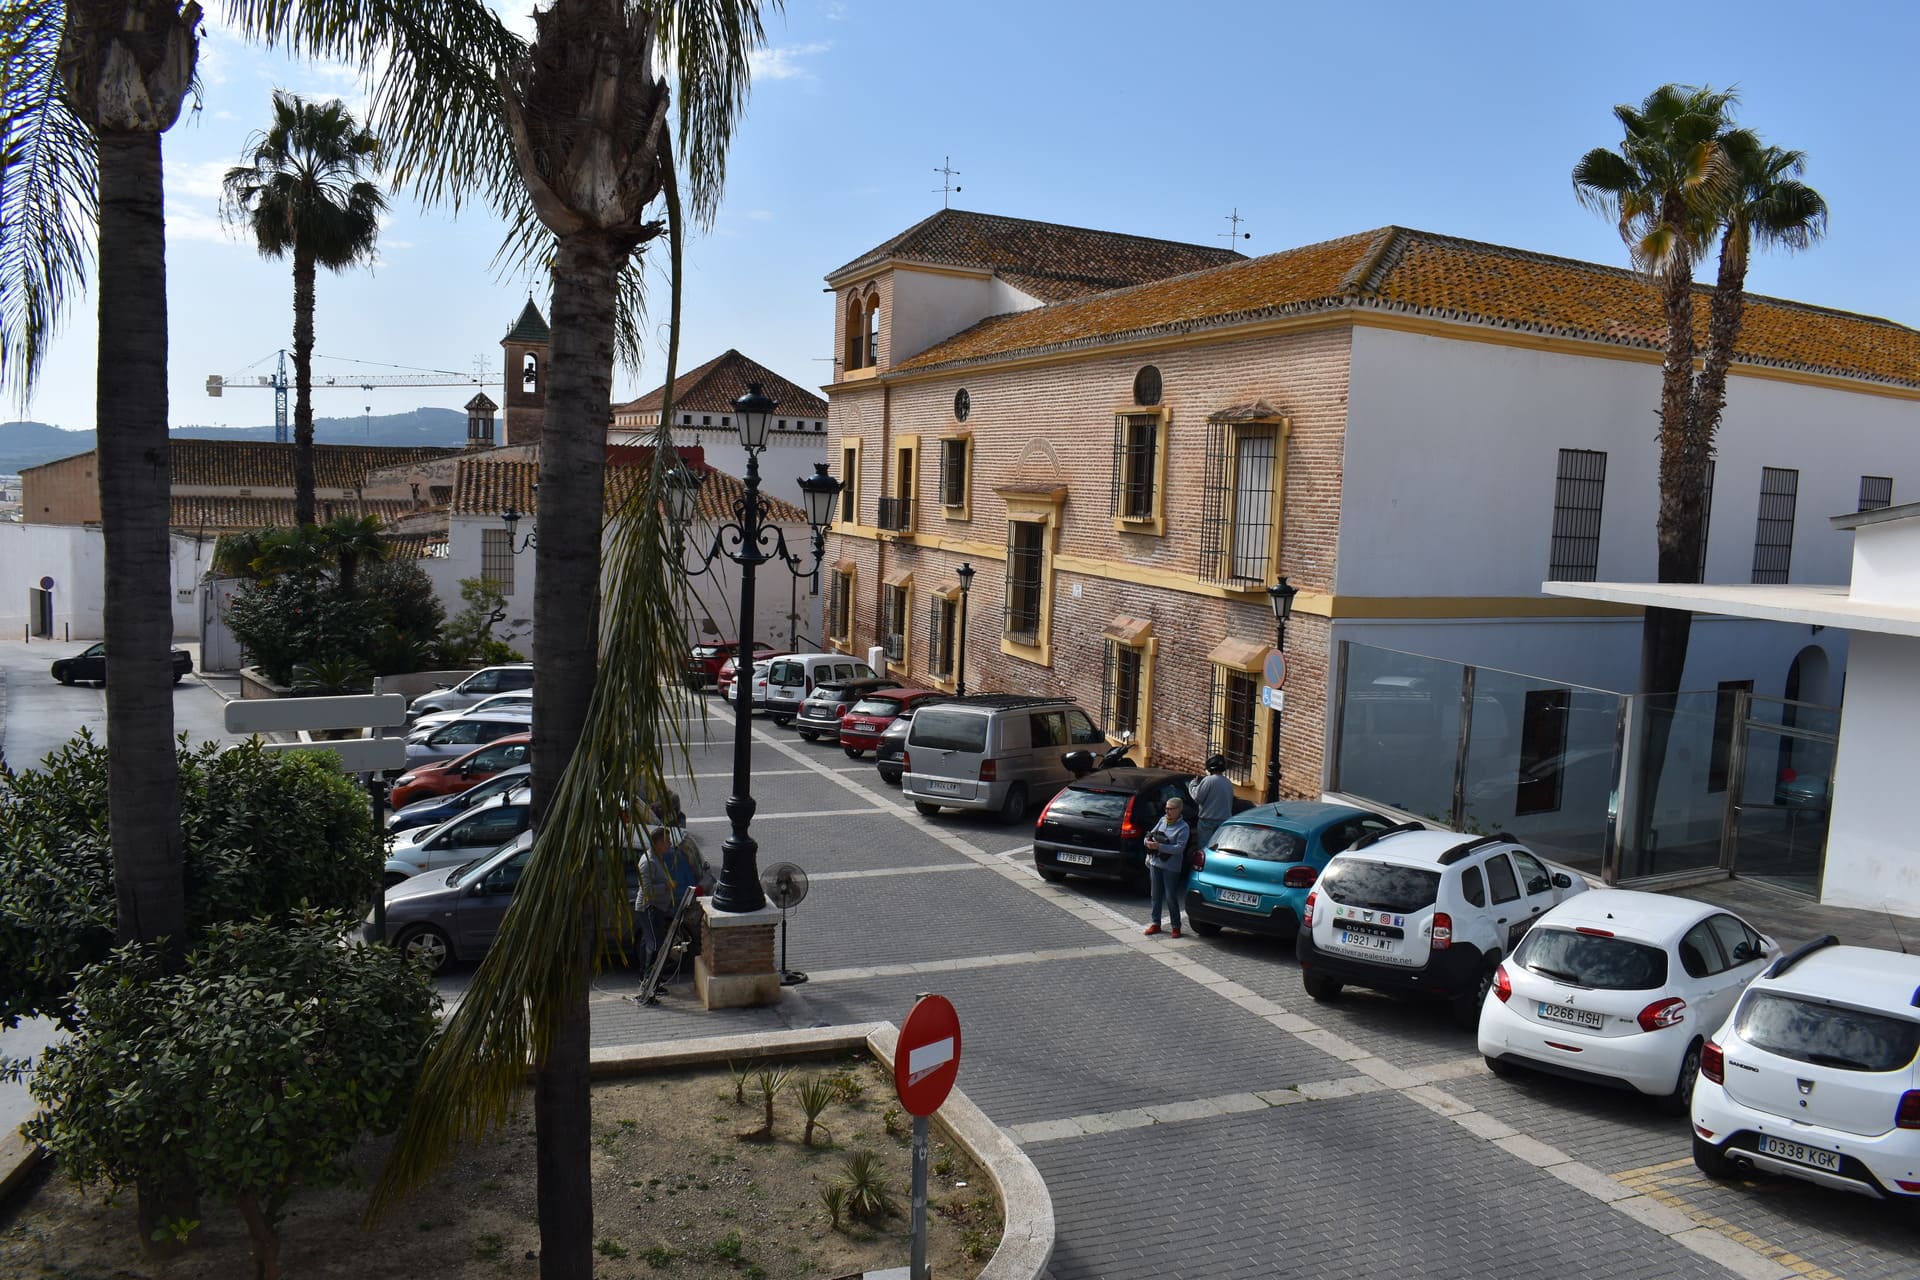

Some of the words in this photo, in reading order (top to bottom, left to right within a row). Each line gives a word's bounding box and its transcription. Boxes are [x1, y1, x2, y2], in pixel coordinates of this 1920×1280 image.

[1346, 924, 1387, 936] DUSTER
[1347, 933, 1370, 946] 0921
[1373, 938, 1393, 951] JWT
[1546, 1005, 1574, 1020] 0266
[1577, 1011, 1600, 1025] HSH
[1728, 1060, 1760, 1073] SANDERO
[1769, 1139, 1804, 1160] 0338
[1808, 1150, 1836, 1168] KGK
